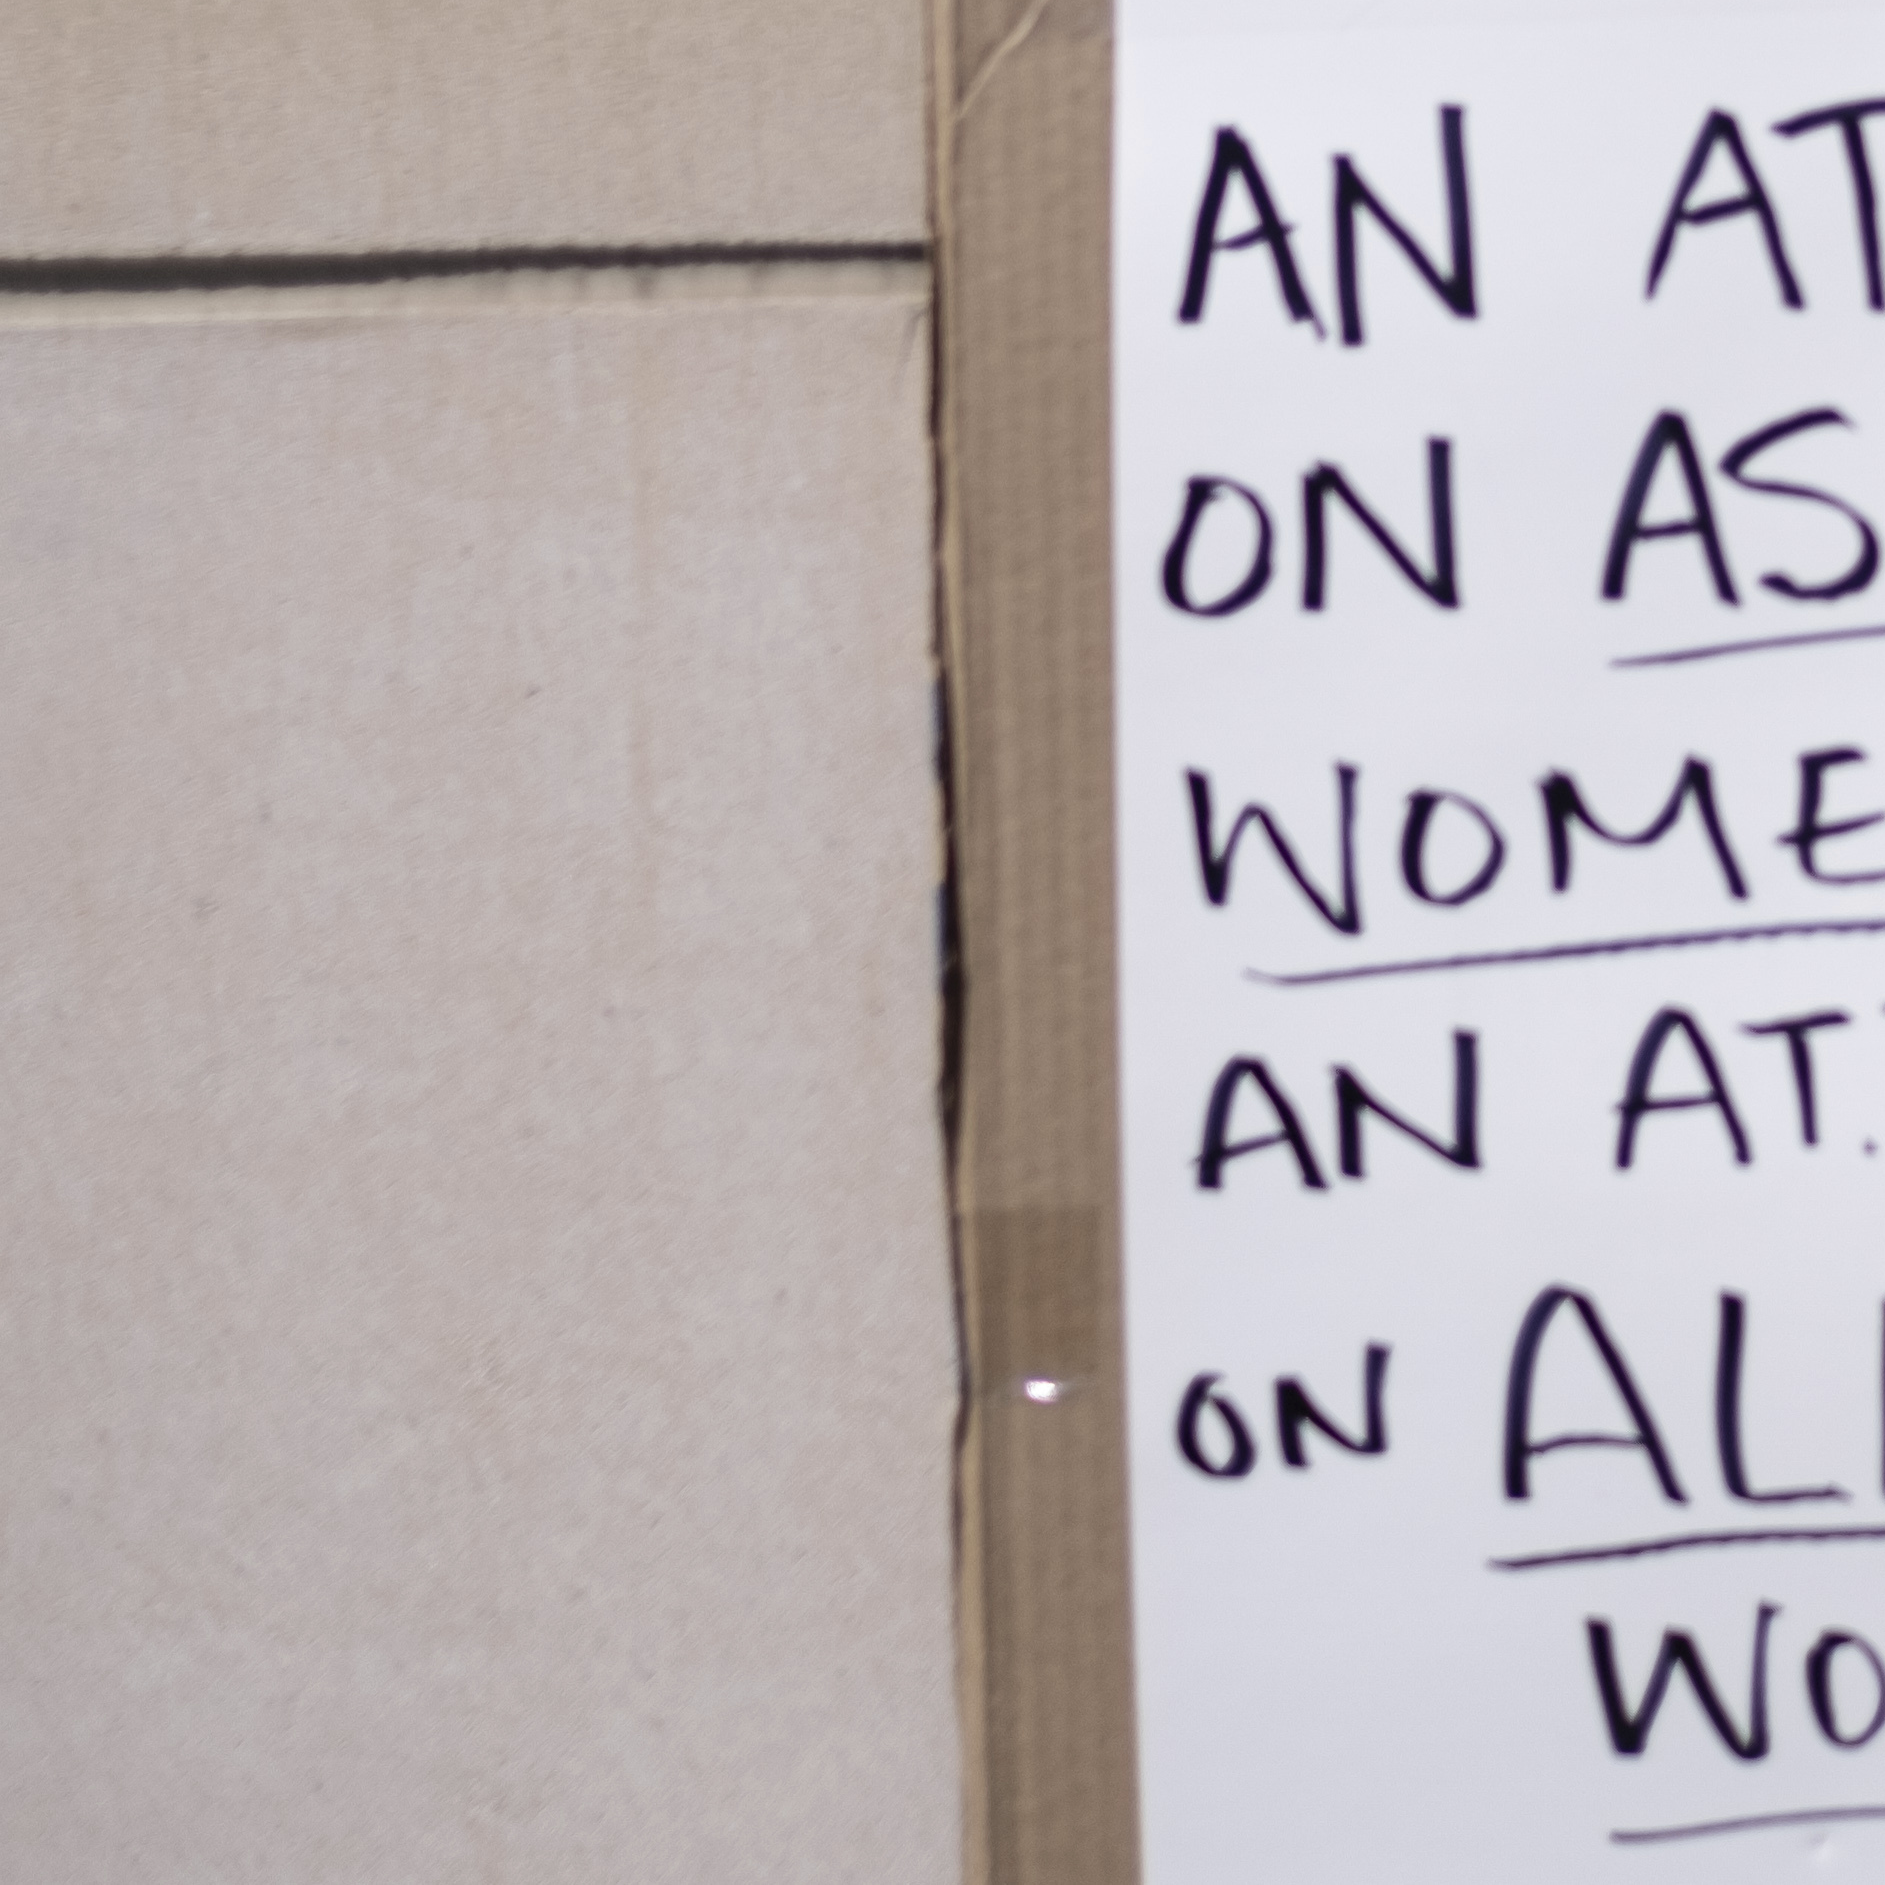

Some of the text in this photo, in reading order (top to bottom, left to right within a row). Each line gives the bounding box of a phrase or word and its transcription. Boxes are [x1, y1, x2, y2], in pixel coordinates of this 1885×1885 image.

[1173, 100, 1483, 352] AN
[1156, 432, 1466, 622] ON
[1189, 1025, 1486, 1196] AN
[1171, 1338, 1394, 1484] ON
